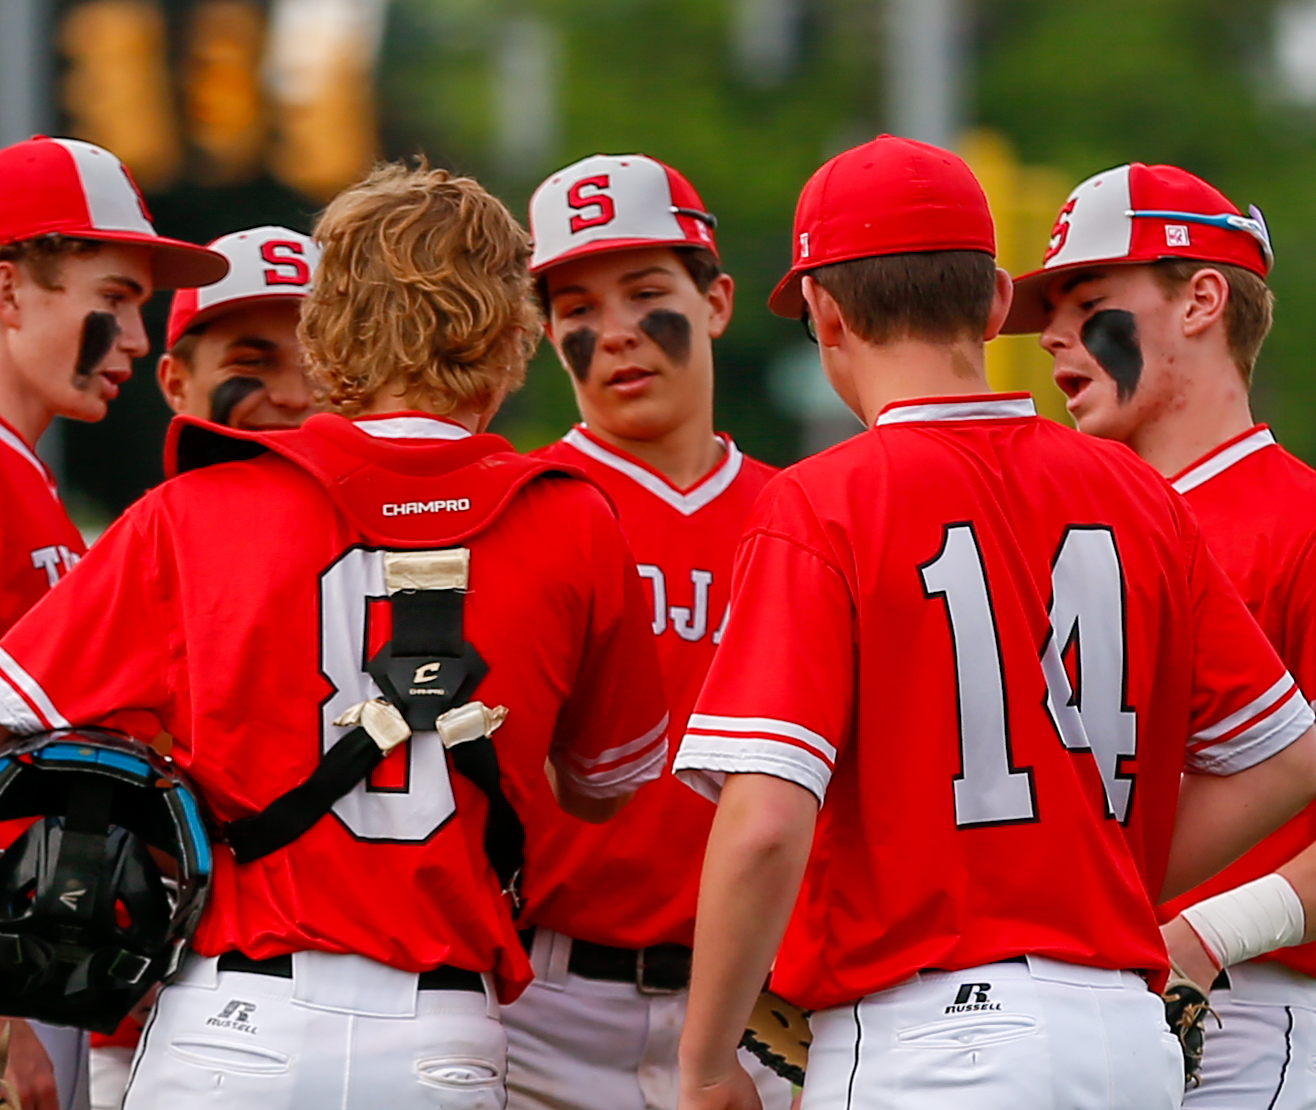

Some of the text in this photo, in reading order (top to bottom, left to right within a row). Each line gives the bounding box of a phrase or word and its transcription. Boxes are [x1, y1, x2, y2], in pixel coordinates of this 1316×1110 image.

[567, 174, 615, 235] S
[260, 240, 310, 285] S
[382, 498, 470, 516] CHAMPRO
[916, 520, 1138, 831] 14
[945, 1002, 1002, 1015] RUSSELL
[205, 1016, 258, 1036] RUSSELL
